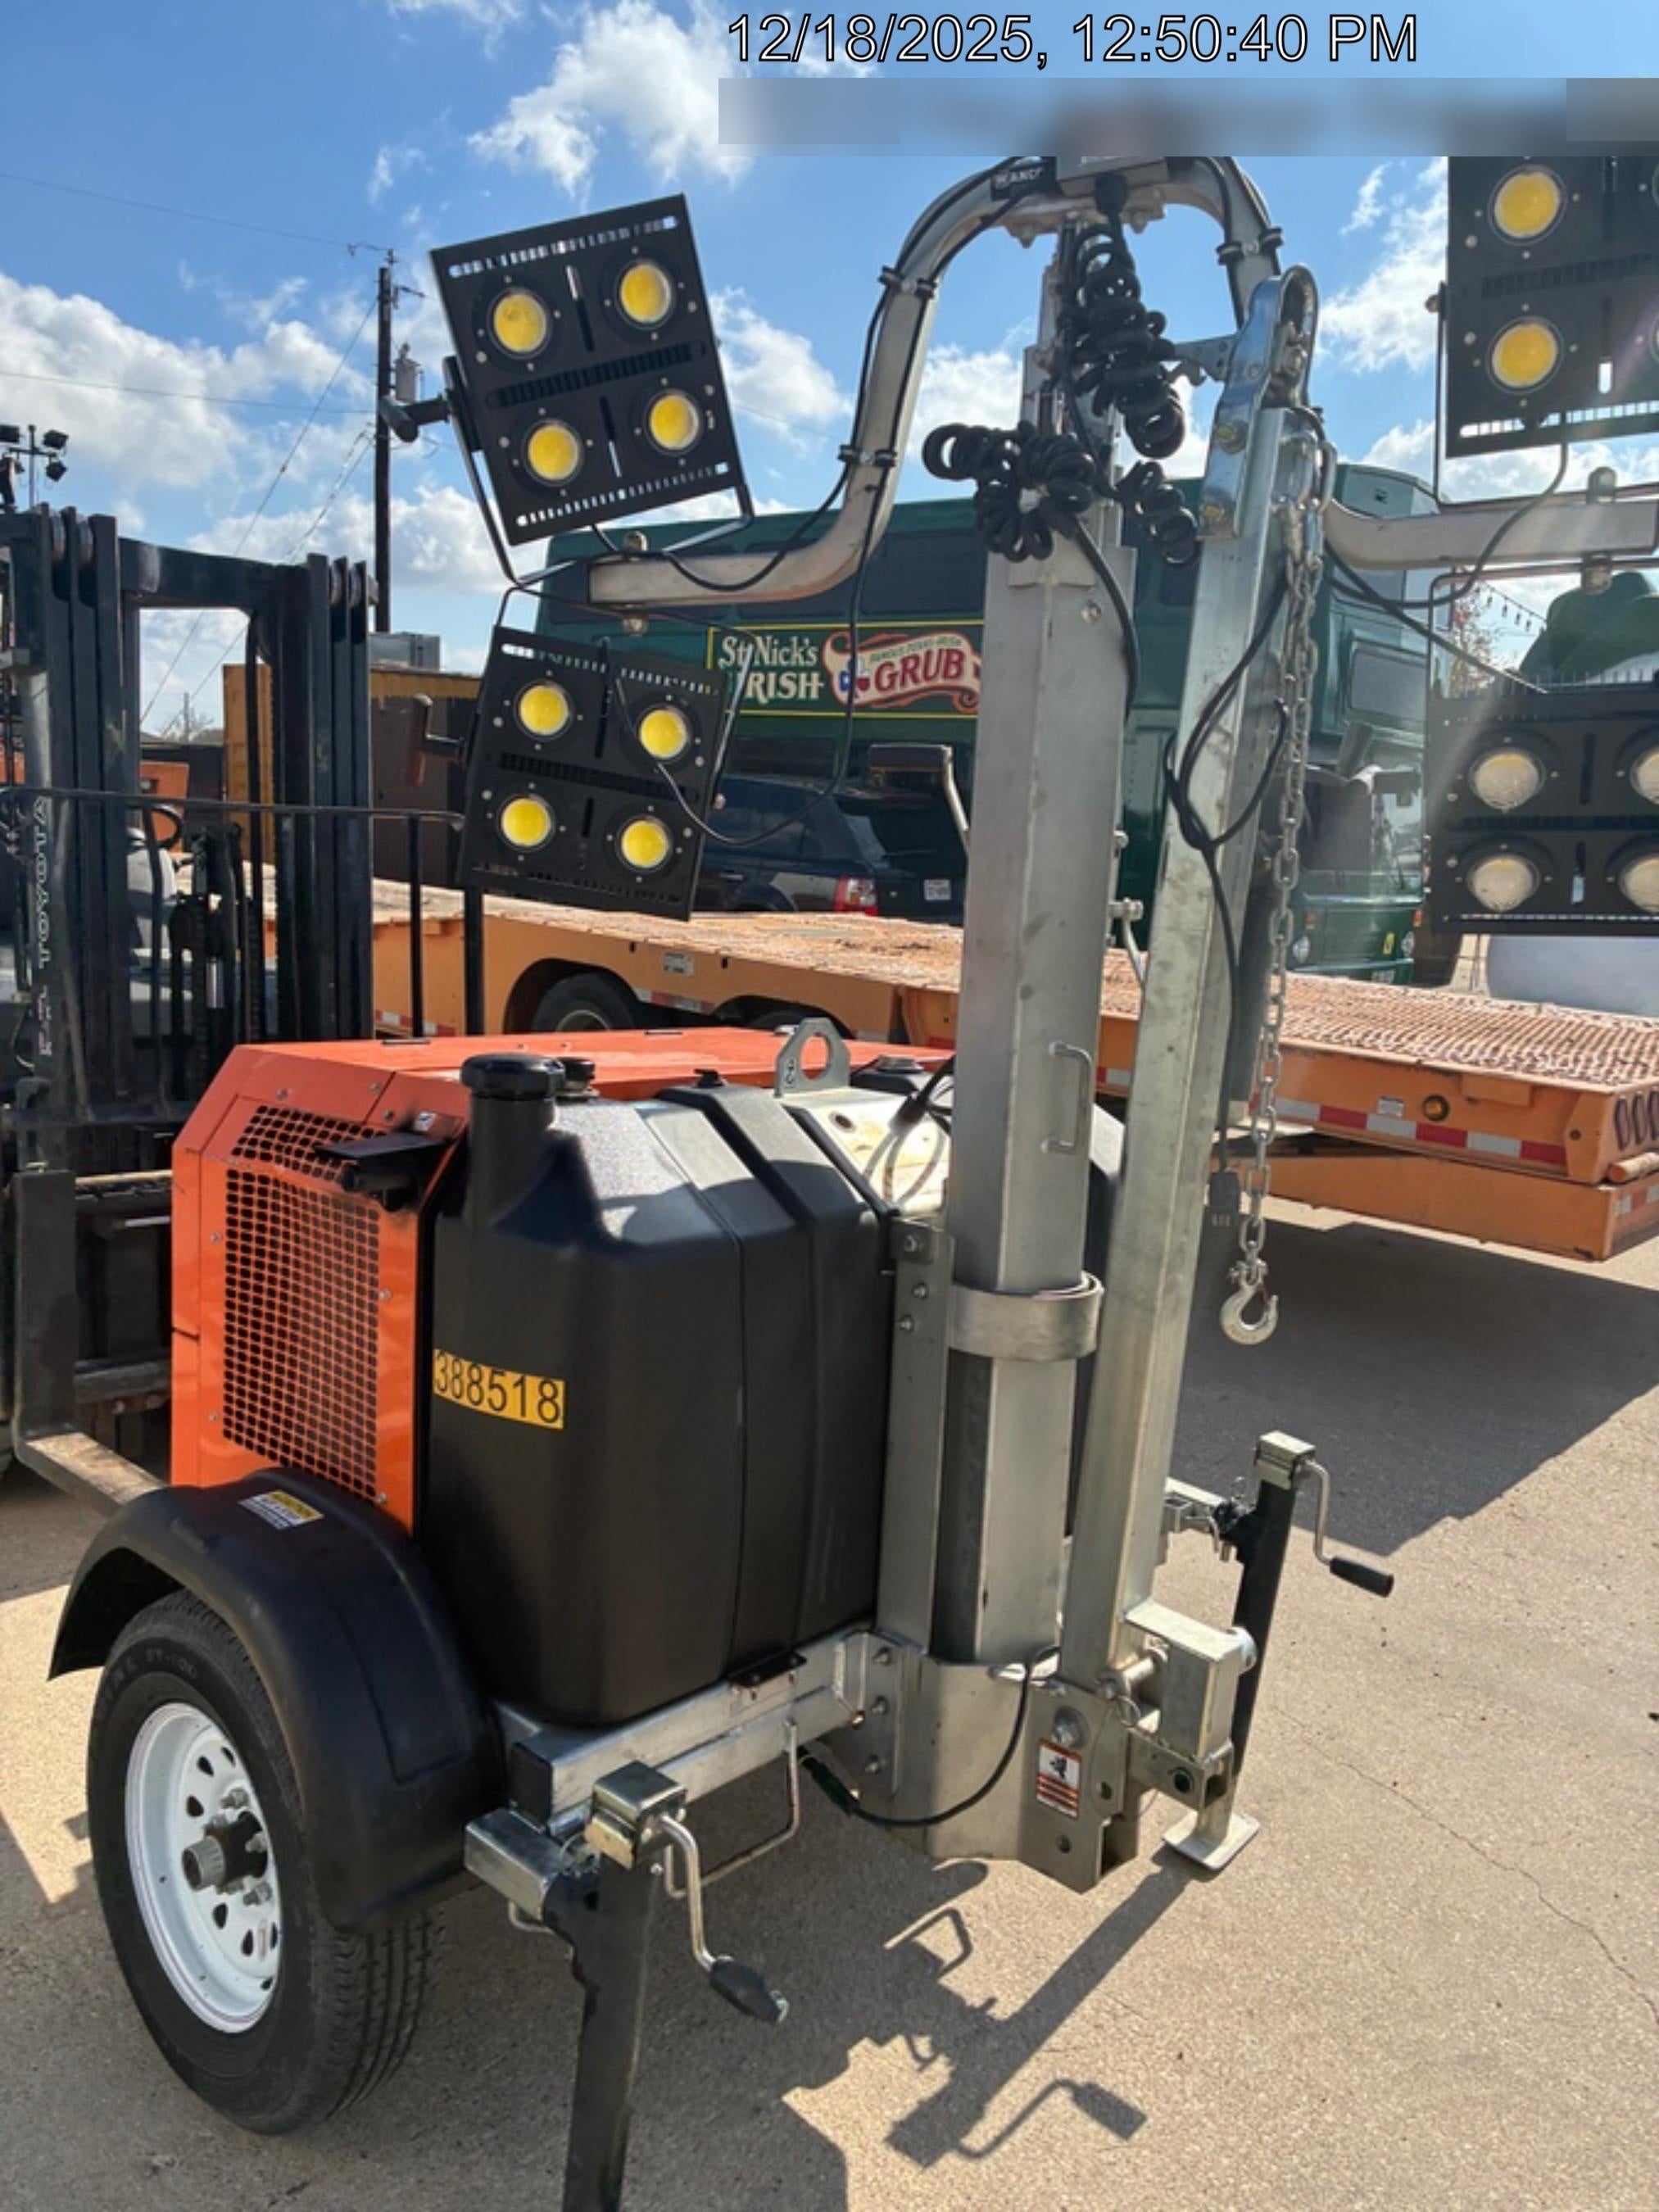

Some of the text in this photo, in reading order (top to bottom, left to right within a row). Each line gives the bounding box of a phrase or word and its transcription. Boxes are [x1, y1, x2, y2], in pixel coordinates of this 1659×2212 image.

[874, 647, 965, 693] GRUB
[34, 795, 52, 968] TOYOTA
[435, 1352, 560, 1423] 388518
